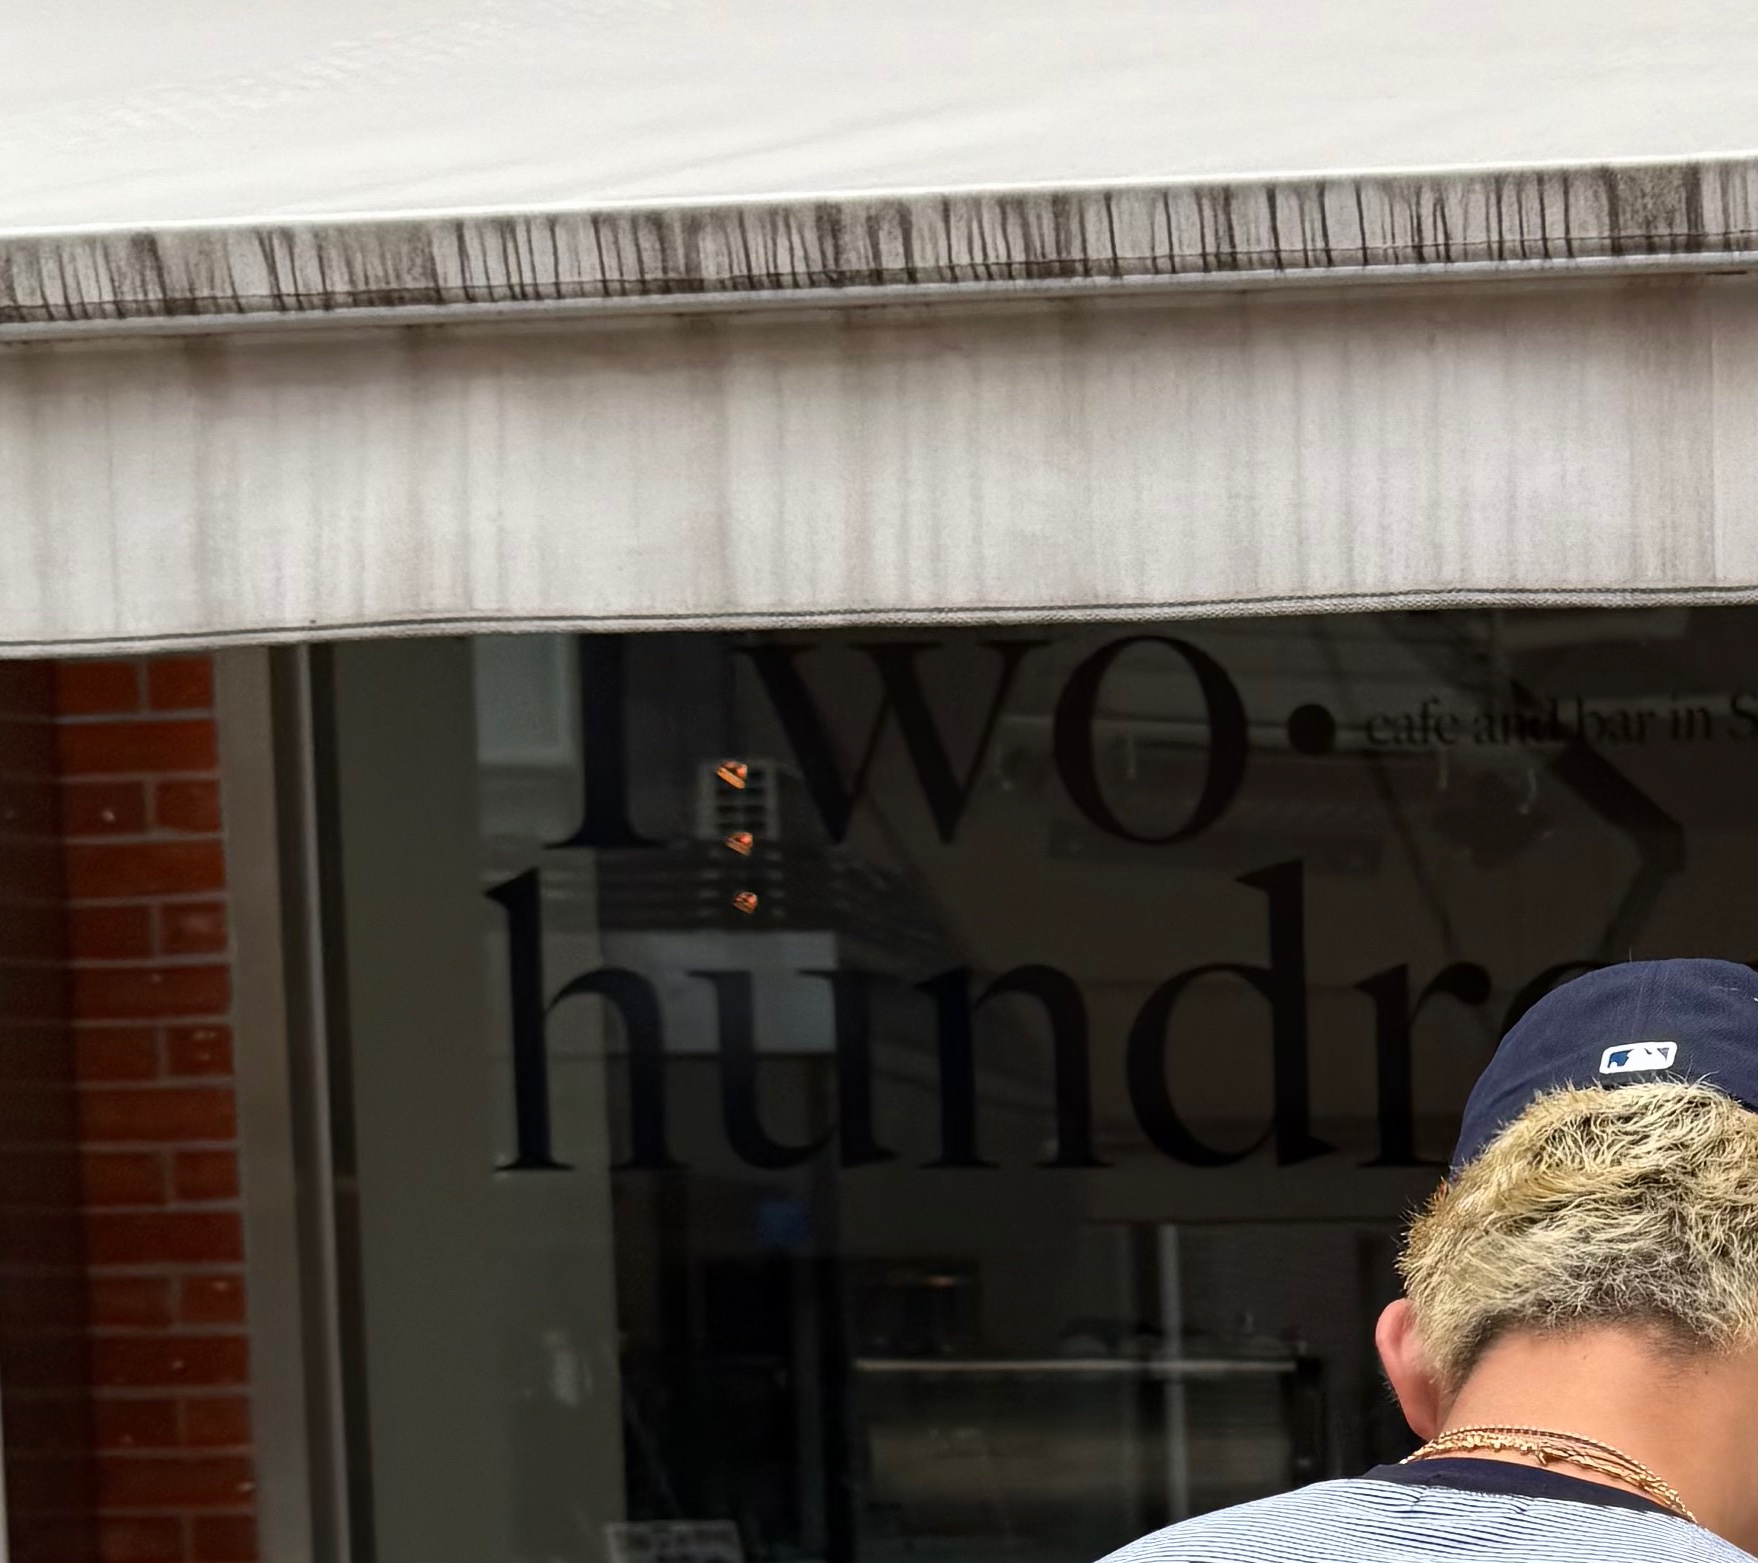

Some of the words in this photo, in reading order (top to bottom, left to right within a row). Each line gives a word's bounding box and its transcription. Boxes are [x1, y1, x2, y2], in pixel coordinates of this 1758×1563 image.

[1365, 698, 1458, 747] cafe
[1474, 696, 1566, 745] and
[1576, 696, 1656, 744] bar
[1671, 692, 1713, 741] in
